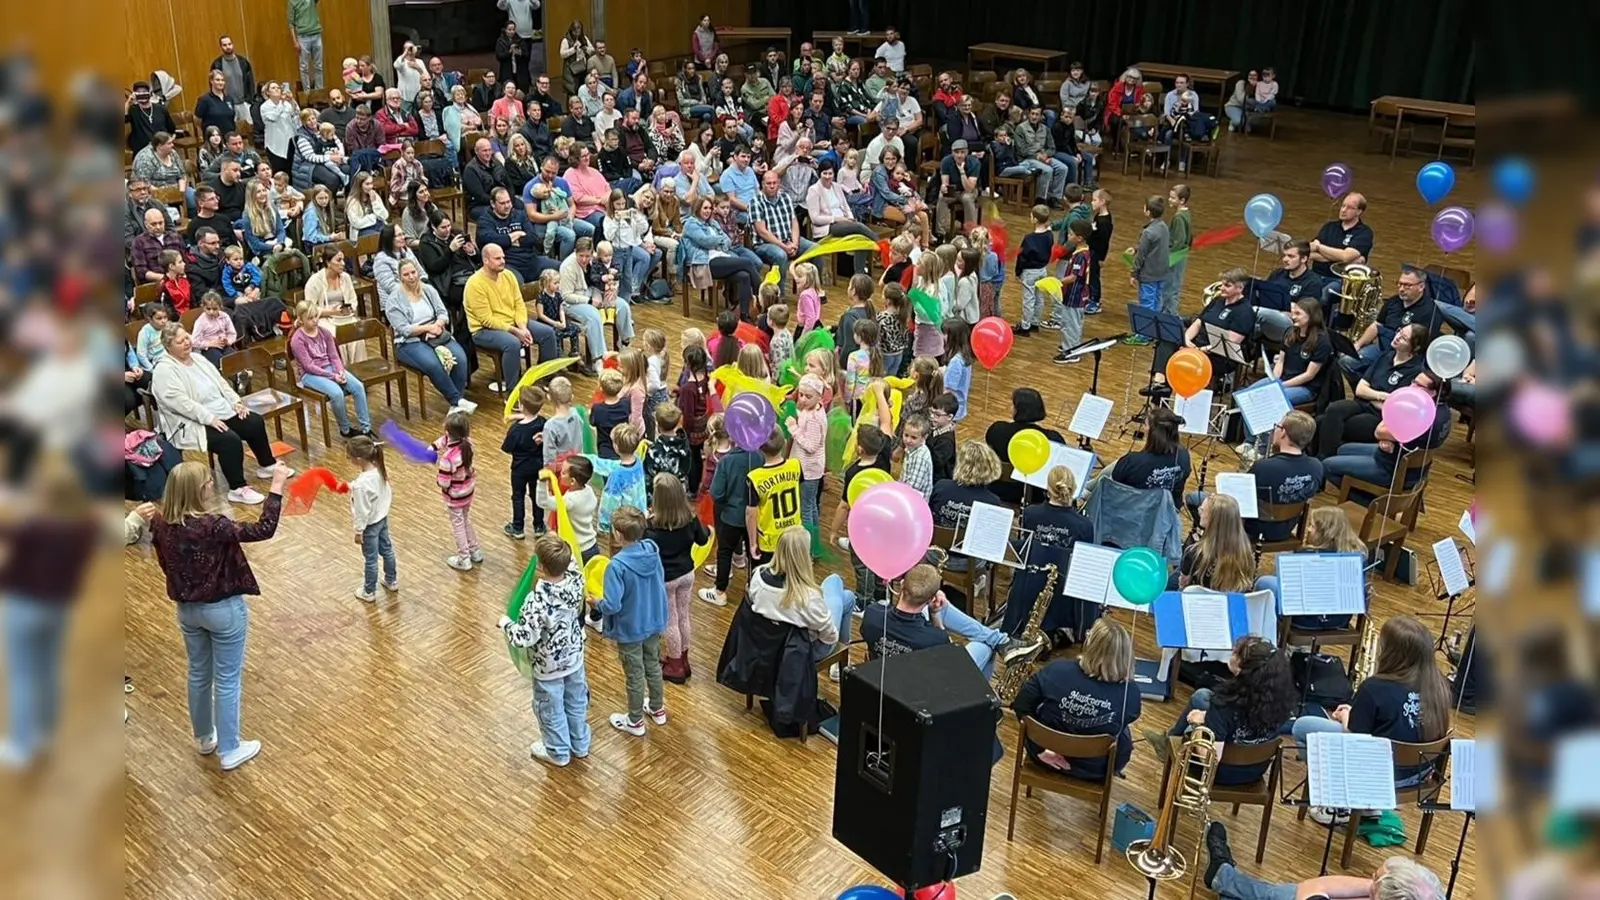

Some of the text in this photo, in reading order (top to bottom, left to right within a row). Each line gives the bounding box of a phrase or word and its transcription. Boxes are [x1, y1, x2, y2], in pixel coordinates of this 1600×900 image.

[768, 487, 798, 519] 10
[1059, 697, 1099, 716] Scherfede
[1069, 690, 1112, 710] Musikverein
